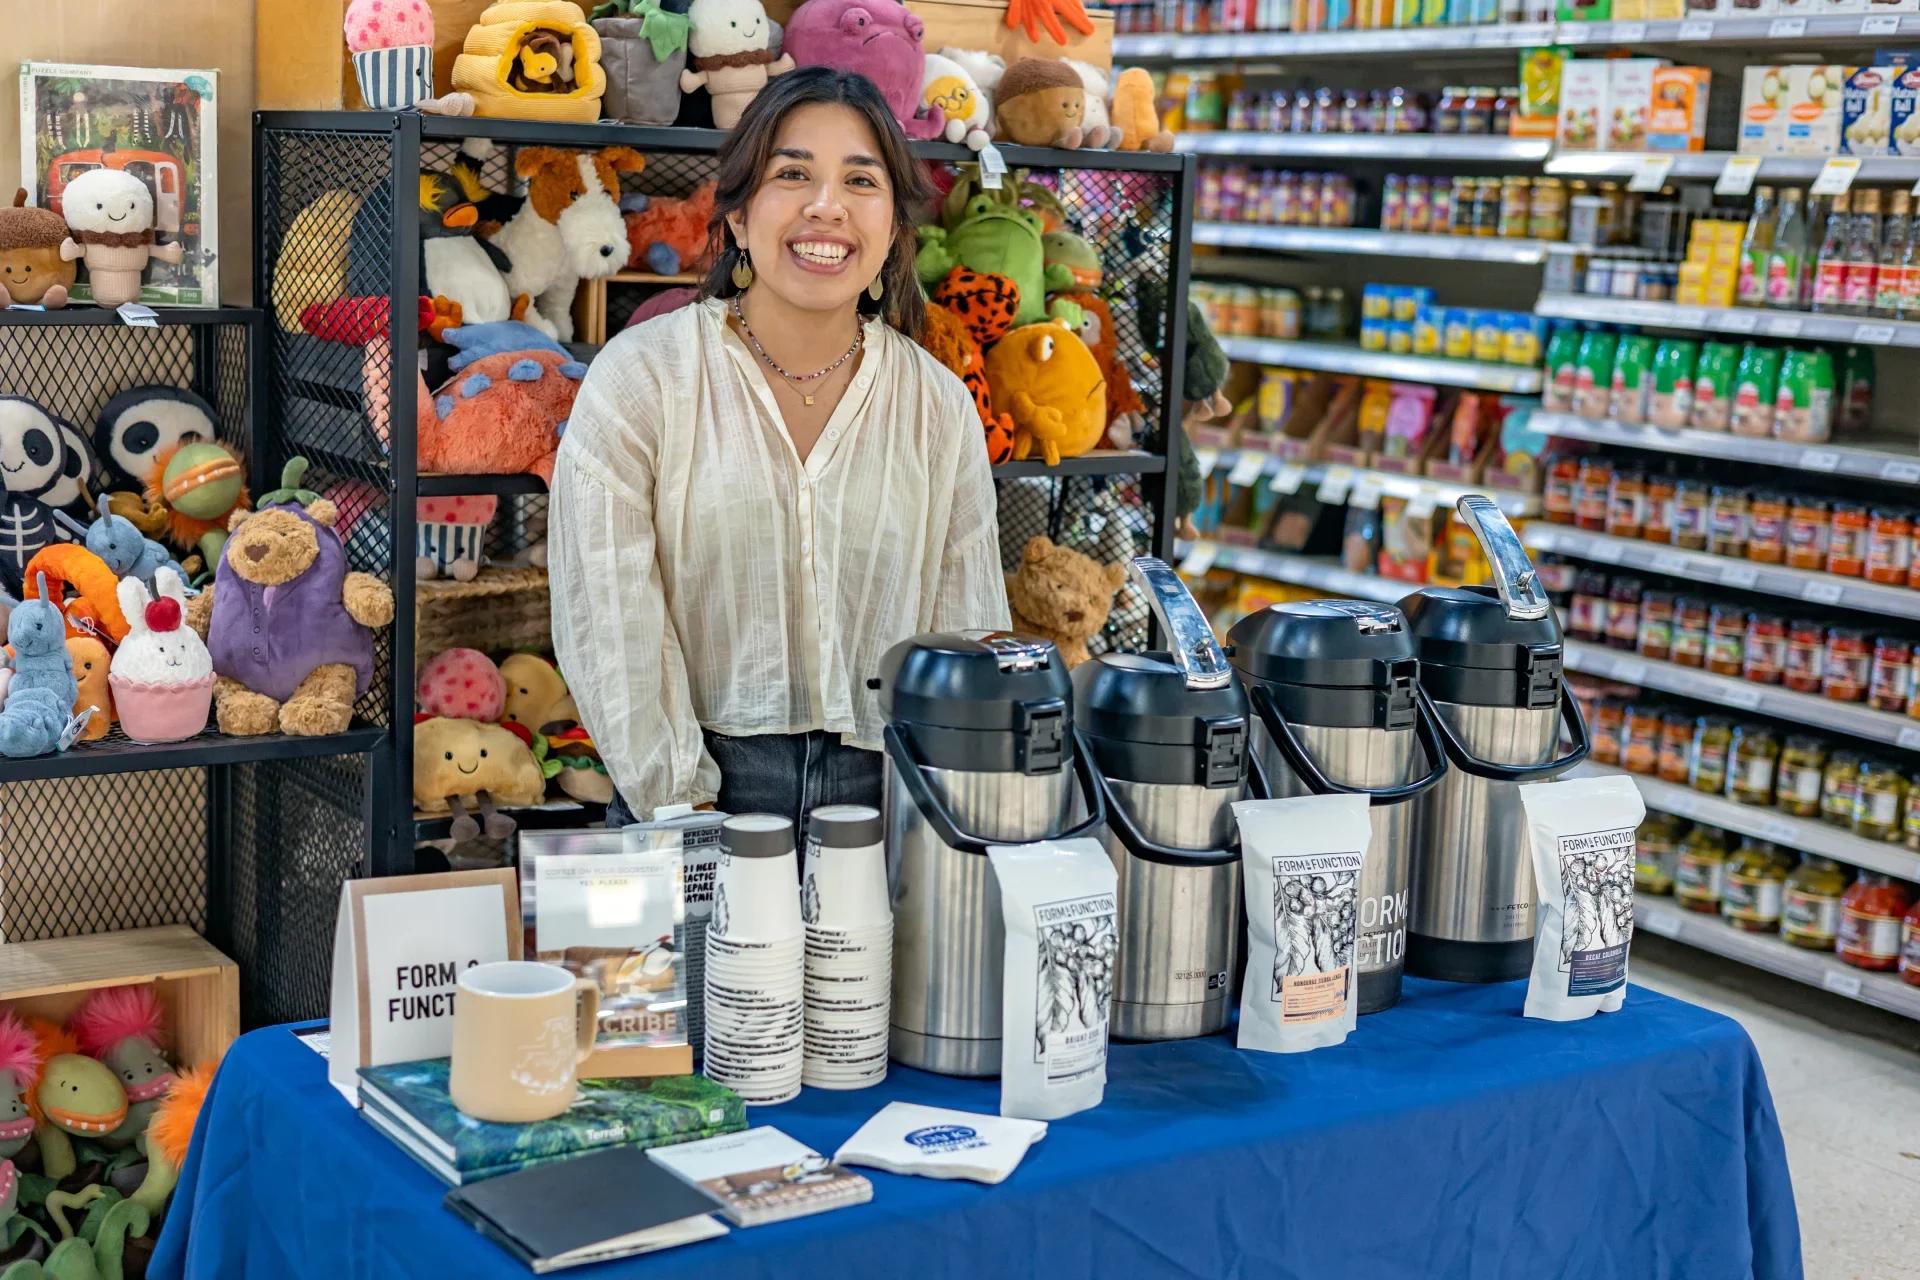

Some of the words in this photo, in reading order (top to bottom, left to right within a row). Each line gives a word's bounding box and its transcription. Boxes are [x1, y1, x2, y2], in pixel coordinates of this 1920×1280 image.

[1563, 837, 1589, 852] FORM
[594, 867, 616, 875] YOUR
[1278, 859, 1306, 872] FORM
[1311, 855, 1361, 869] FUNCTION
[1039, 906, 1065, 922] FORM
[1070, 898, 1115, 916] FUNCTION
[1360, 889, 1407, 928] ORM
[396, 961, 457, 991] FORM
[388, 992, 457, 1022] FUNCT
[603, 1011, 677, 1034] CRIBE
[586, 1126, 626, 1140] Terroir
